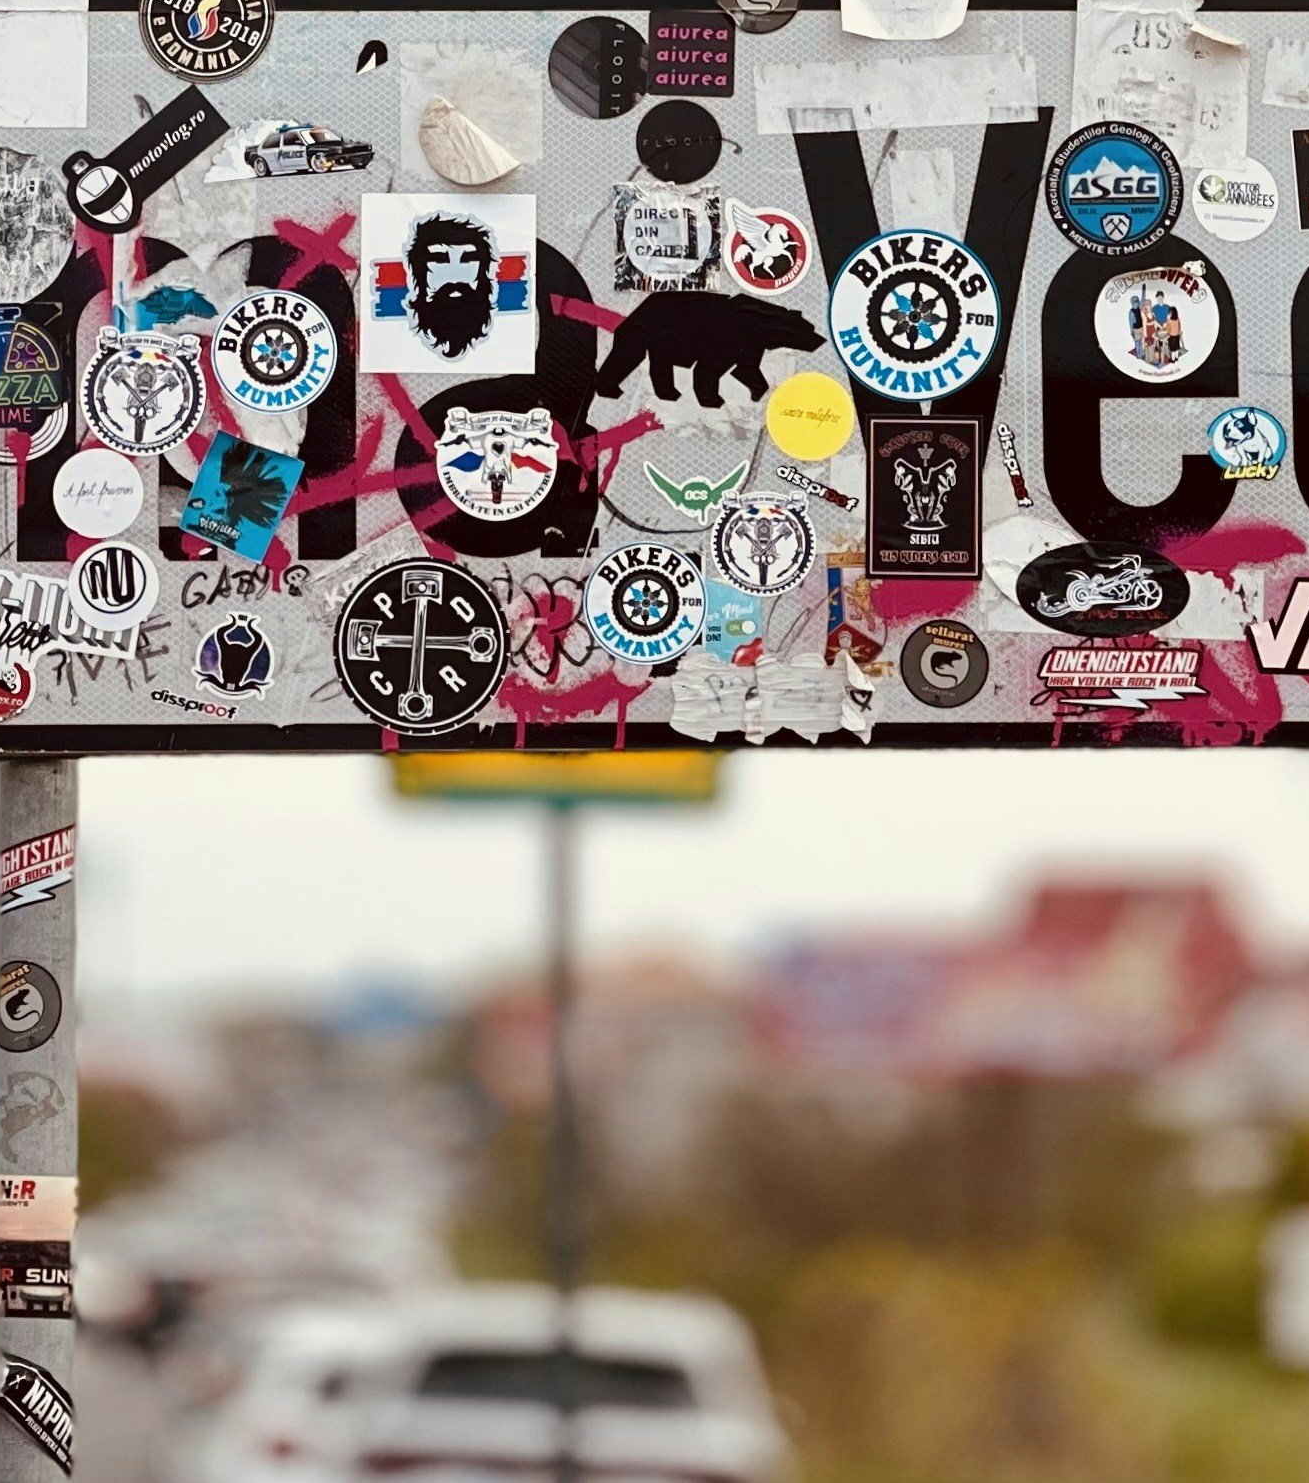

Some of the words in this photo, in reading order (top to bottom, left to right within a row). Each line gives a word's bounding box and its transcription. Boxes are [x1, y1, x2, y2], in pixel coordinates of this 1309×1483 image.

[219, 17, 261, 48] 2018
[656, 22, 729, 40] aiurea
[158, 31, 241, 70] ROMÂNIA
[656, 45, 728, 64] aiurea
[655, 68, 728, 86] aiurea
[128, 107, 207, 179] motovlog.ro
[1071, 176, 1157, 198] ASGG
[1227, 180, 1261, 194] DOCTOR
[635, 226, 659, 238] DIN
[1068, 229, 1105, 255] MENTE
[1107, 245, 1122, 255] ET
[1123, 227, 1165, 255] MALLEO
[847, 235, 989, 300] BIKERS
[218, 296, 308, 354] BIKERS
[966, 312, 995, 328] FOR
[839, 326, 982, 394] HUMANITY
[234, 343, 330, 407] HUMANITY
[684, 488, 708, 501] OCS
[909, 533, 940, 545] SIBIU
[591, 546, 696, 591] BIKERS
[593, 613, 695, 658] HUMANITY
[924, 624, 975, 644] sellarat
[1051, 650, 1199, 673] ONENIGHTSTAND
[1078, 676, 1125, 687] VOLTAGE
[151, 688, 238, 721] dissproof
